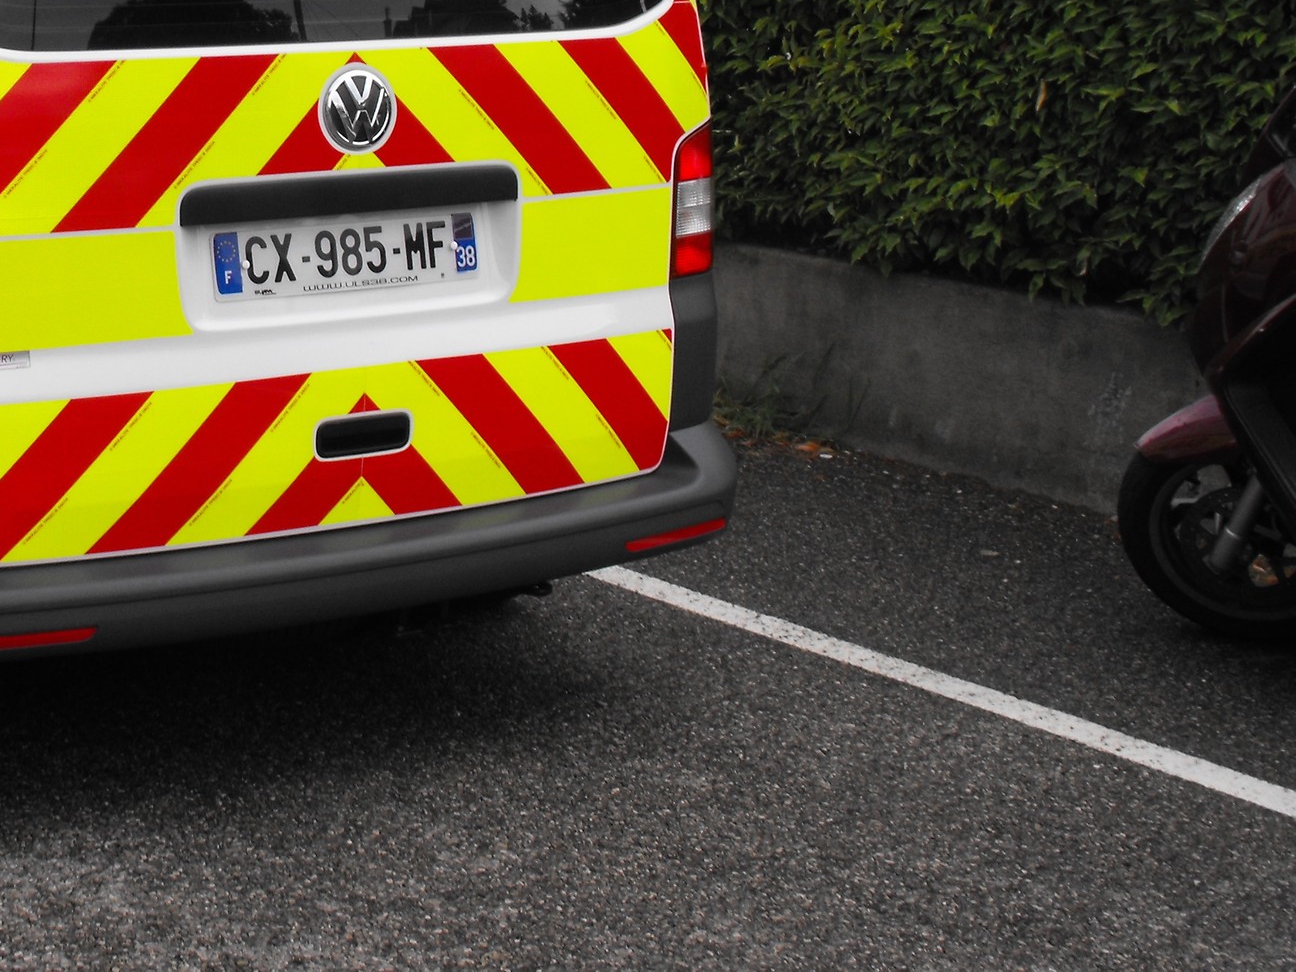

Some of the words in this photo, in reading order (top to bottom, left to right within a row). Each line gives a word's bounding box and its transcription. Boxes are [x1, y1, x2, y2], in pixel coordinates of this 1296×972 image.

[224, 270, 233, 284] F
[245, 220, 446, 285] CX-985-MF
[456, 245, 476, 268] 38
